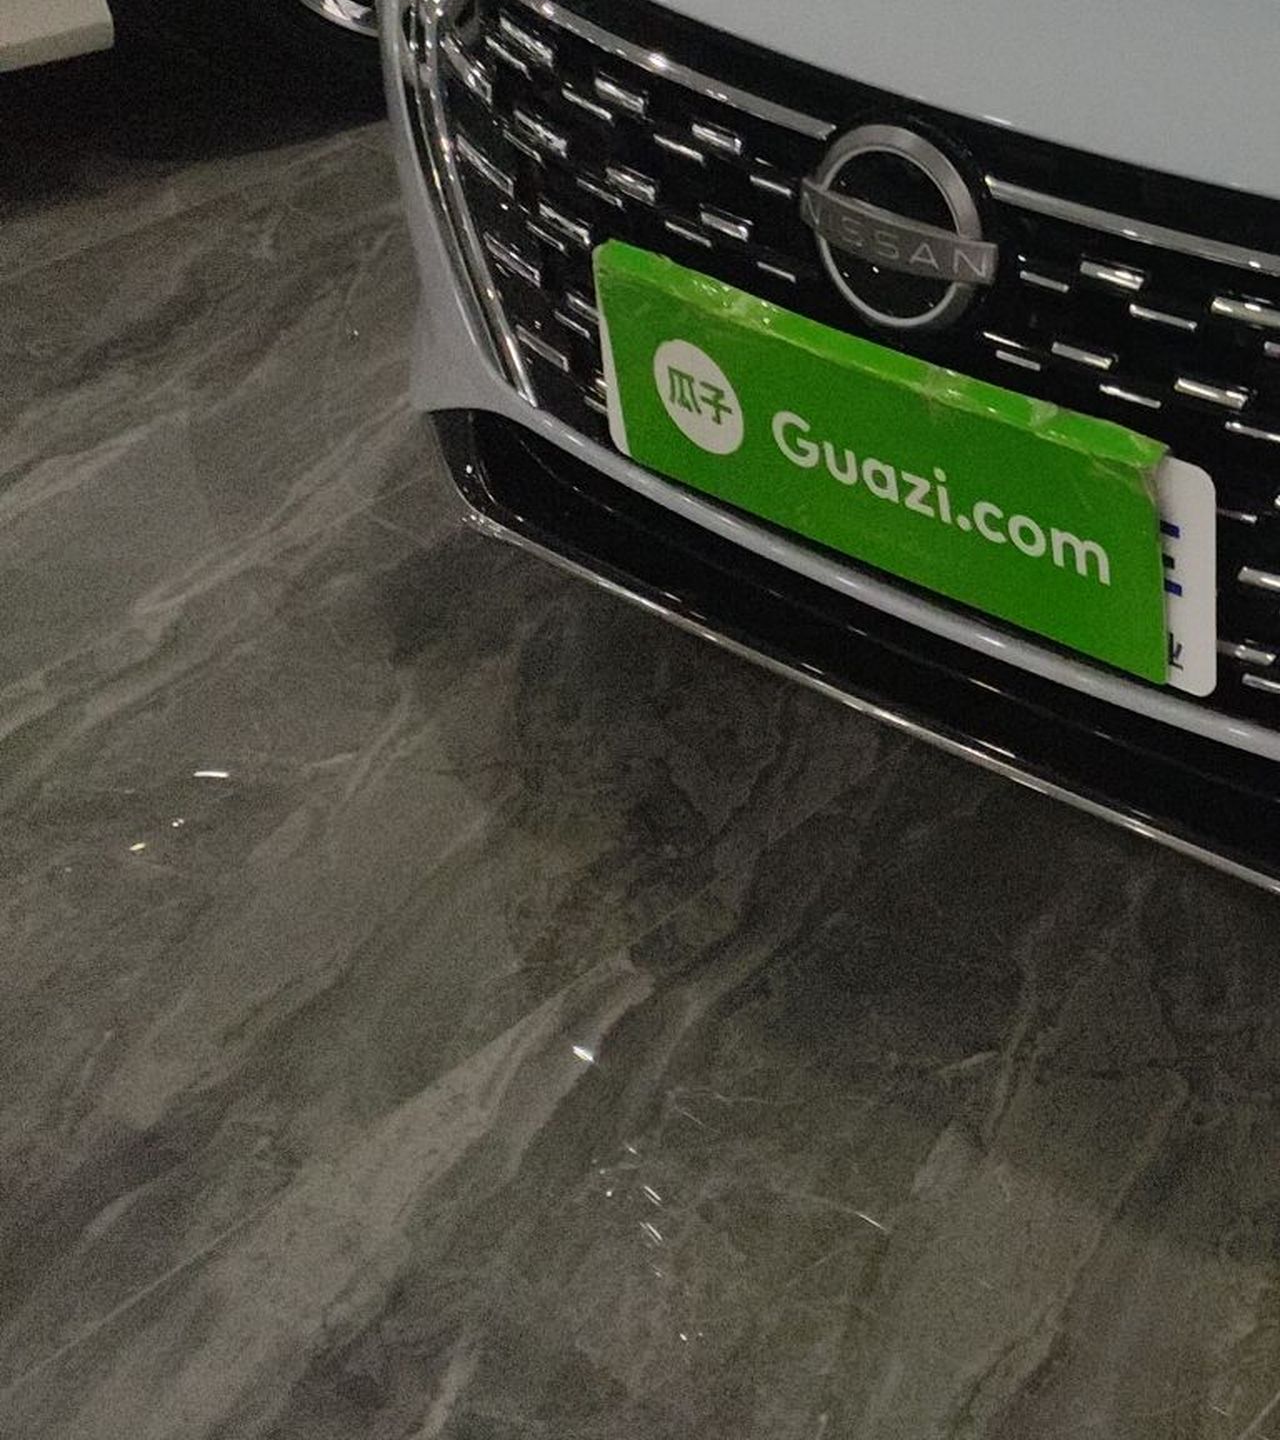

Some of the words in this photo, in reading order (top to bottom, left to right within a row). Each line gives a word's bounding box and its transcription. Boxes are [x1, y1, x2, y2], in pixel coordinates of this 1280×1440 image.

[802, 190, 987, 279] NISSAN
[667, 366, 733, 426] 瓜子
[772, 411, 1111, 586] Guazi.com
